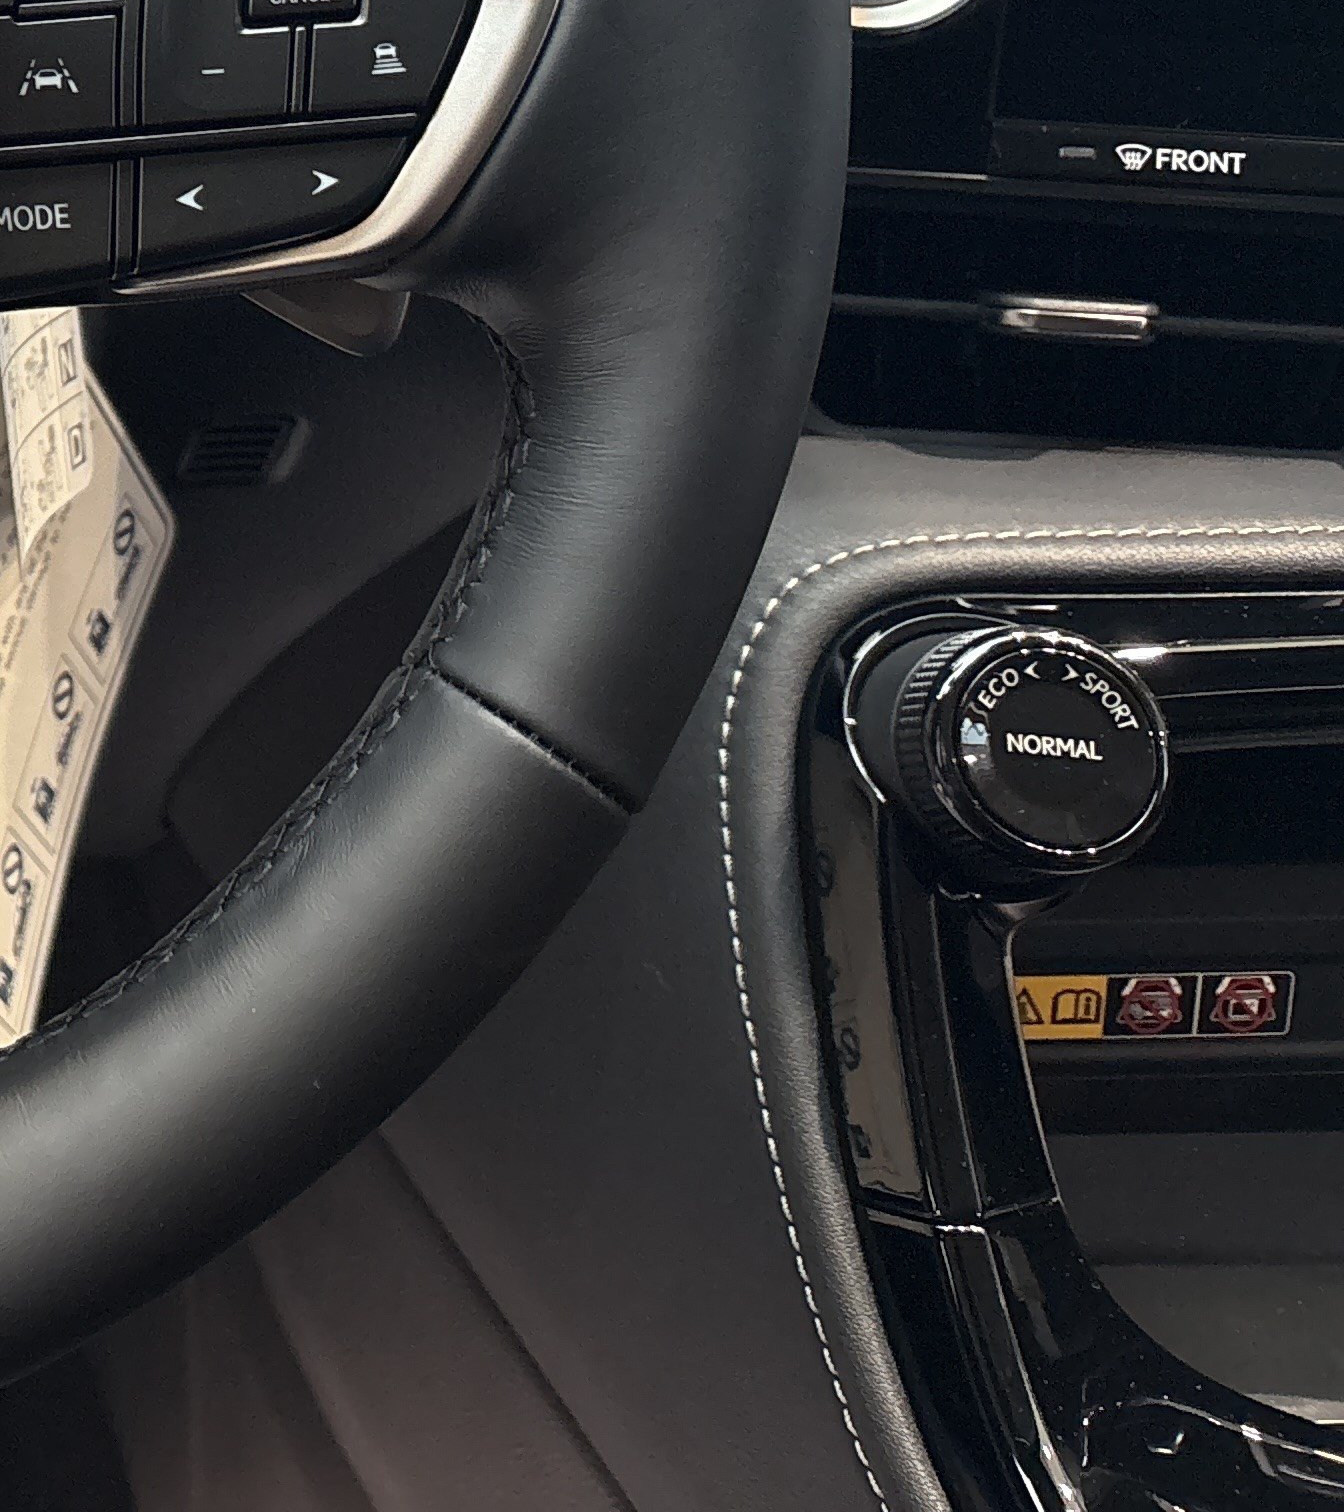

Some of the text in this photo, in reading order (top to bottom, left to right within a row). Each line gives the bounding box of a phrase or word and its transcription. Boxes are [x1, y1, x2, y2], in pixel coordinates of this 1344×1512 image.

[1155, 147, 1247, 176] FRONT
[977, 668, 1020, 710] ECO
[1079, 672, 1139, 730] SPORT
[1005, 732, 1104, 762] NORMAL
